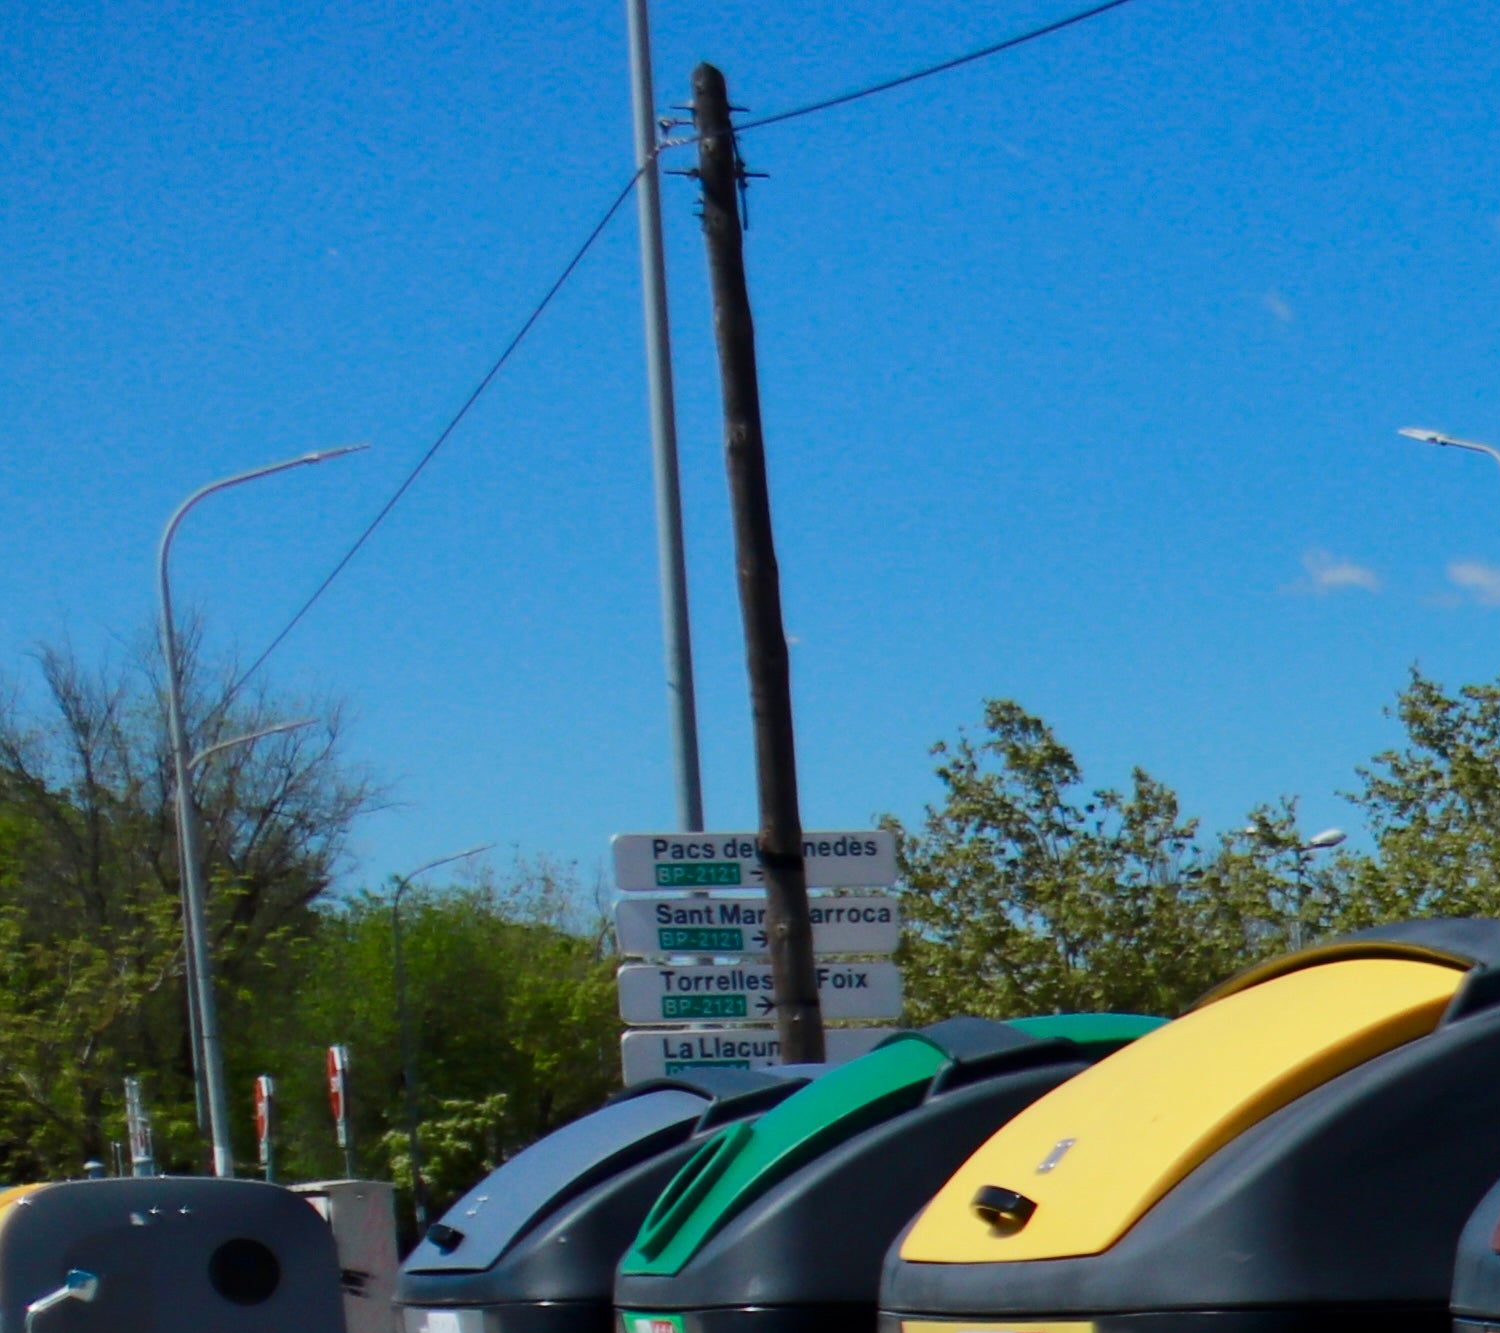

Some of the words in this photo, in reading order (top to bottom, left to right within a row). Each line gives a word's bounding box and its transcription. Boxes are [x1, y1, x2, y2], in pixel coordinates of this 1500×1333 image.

[652, 839, 716, 860] Pacs
[803, 836, 878, 858] nedès
[657, 867, 741, 884] BP-2121
[656, 904, 714, 925] Sant
[719, 904, 766, 924] Mar
[810, 907, 891, 924] arroca
[660, 932, 743, 948] BP-2121
[660, 971, 773, 991] Torrelles
[815, 969, 868, 989] Foix
[664, 998, 745, 1015] BP-2121
[663, 1038, 693, 1058] La
[699, 1037, 781, 1058] Llacun
